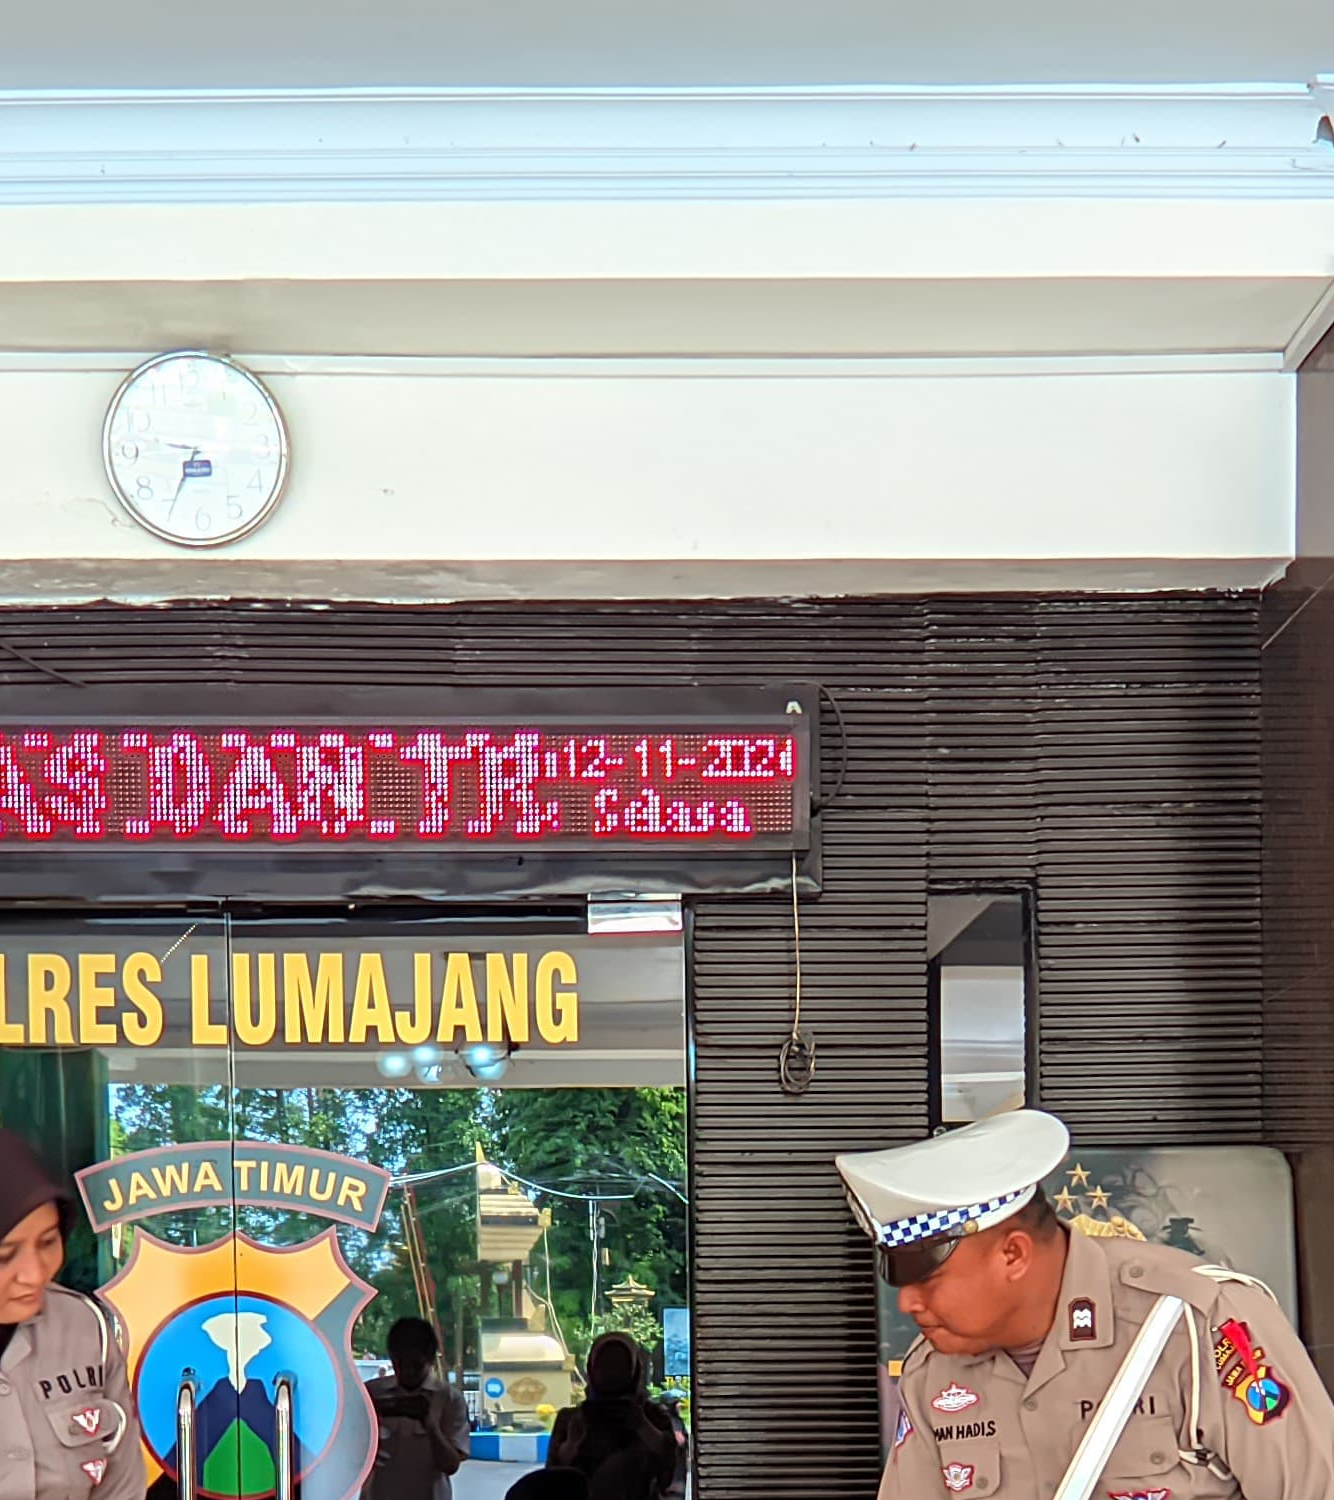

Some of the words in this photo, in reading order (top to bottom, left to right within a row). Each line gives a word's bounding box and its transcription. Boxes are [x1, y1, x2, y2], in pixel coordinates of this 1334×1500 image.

[121, 441, 139, 466] 9
[136, 476, 154, 500] 8
[191, 951, 579, 1046] LUMAJANG
[103, 1161, 222, 1212] JAWA
[234, 1160, 367, 1212] TIMUR
[39, 1364, 105, 1399] POLRI
[955, 1420, 997, 1441] HADIS
